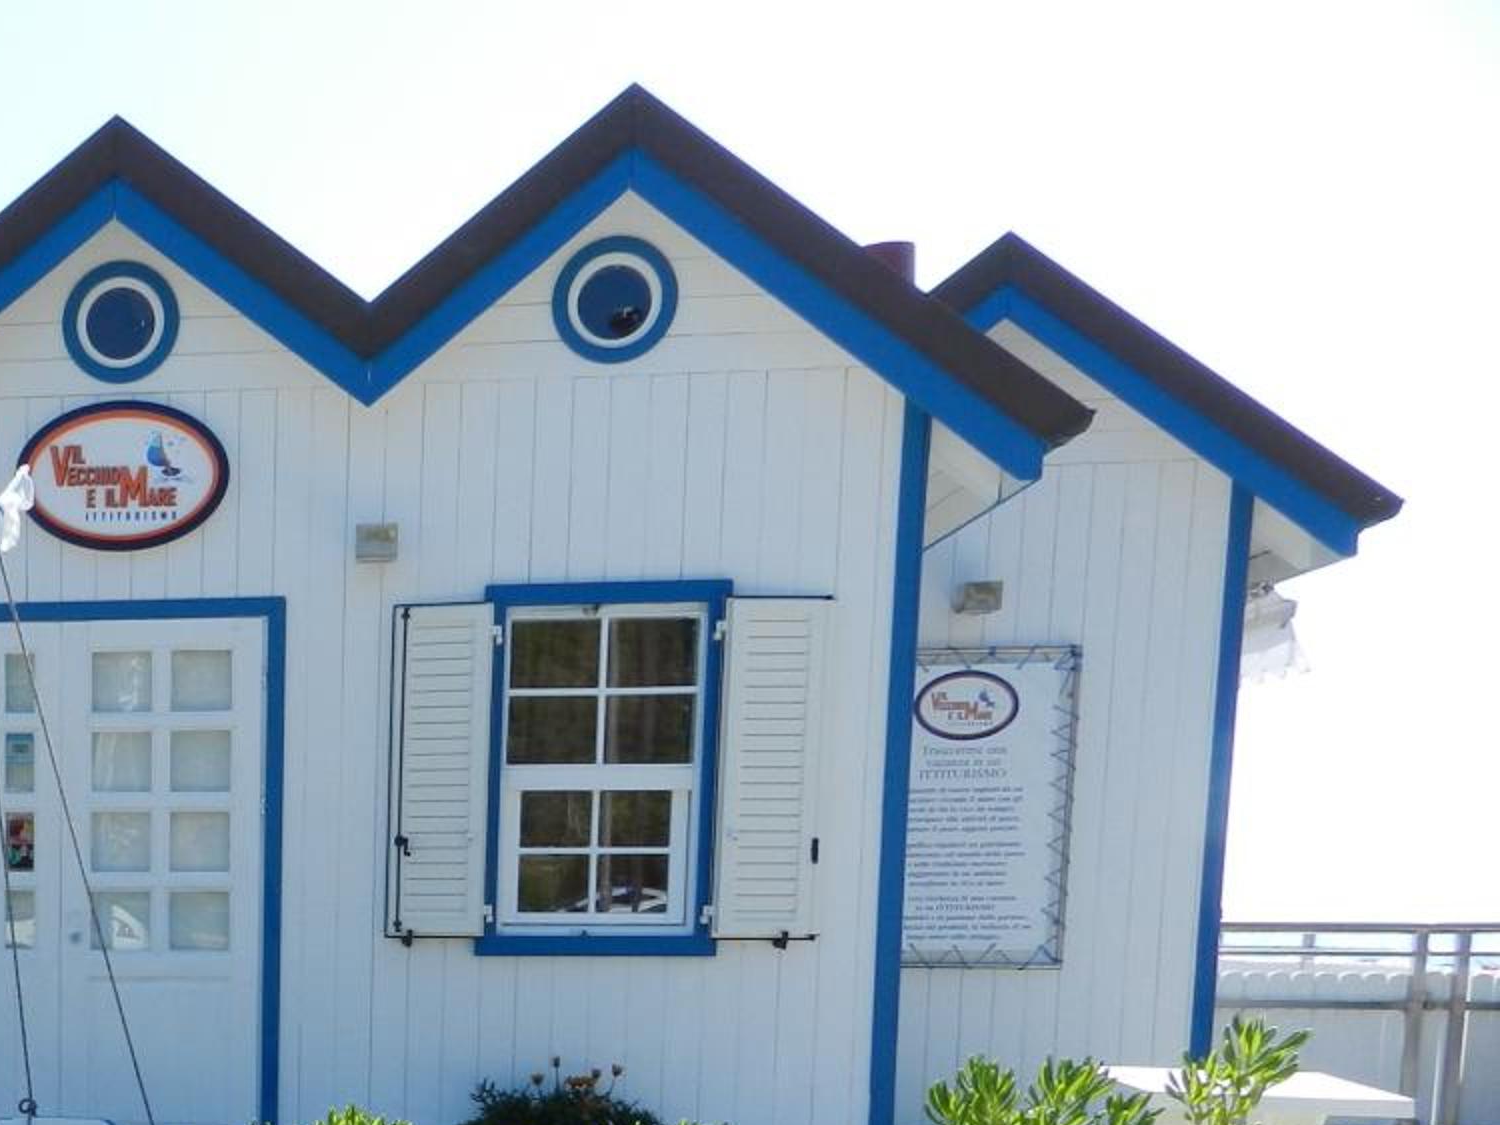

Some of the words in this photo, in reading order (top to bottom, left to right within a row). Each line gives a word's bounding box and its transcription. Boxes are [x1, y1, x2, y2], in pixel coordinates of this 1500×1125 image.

[50, 445, 121, 487] VECCHIO
[86, 488, 96, 509] E
[105, 488, 119, 508] IL
[120, 465, 177, 507] MARE
